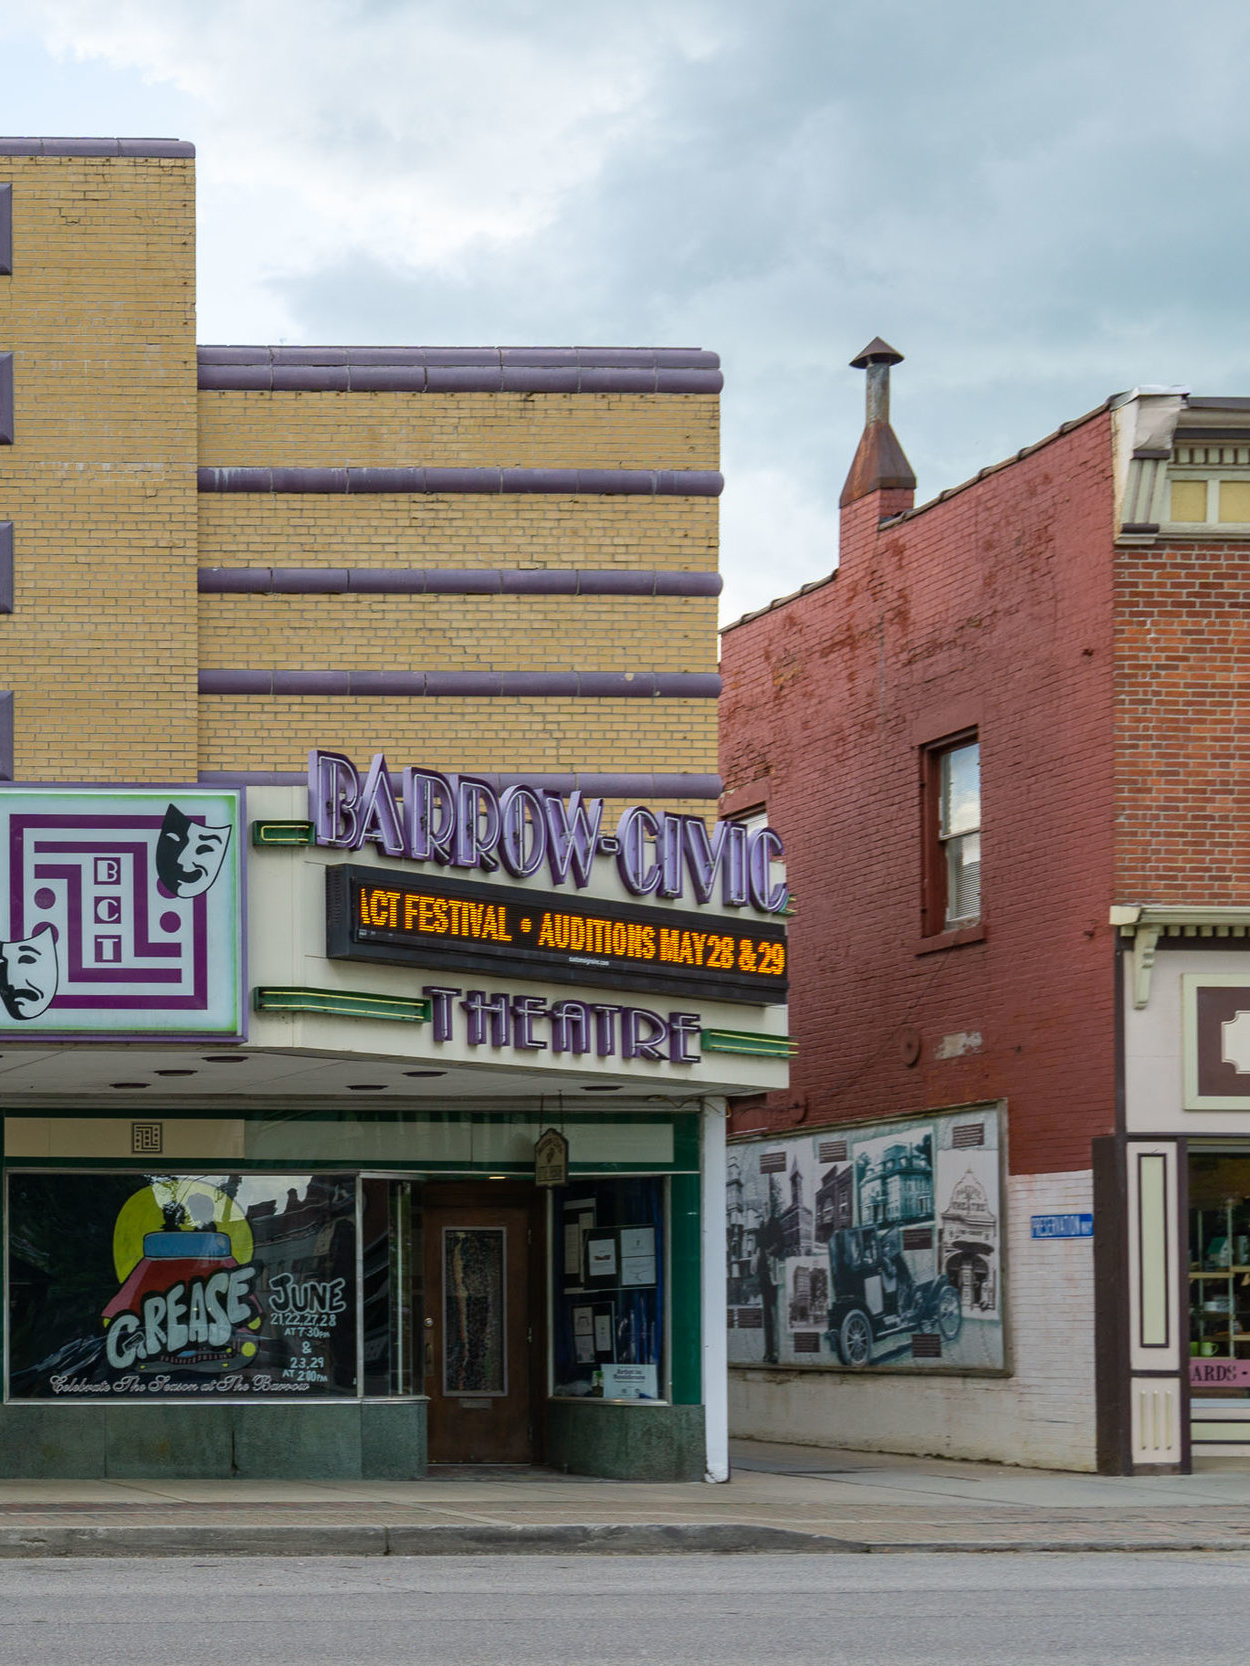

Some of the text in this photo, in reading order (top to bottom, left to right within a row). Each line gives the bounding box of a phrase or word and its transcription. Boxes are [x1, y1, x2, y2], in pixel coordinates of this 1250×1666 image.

[308, 749, 789, 914] BARROW-CIVIC
[404, 893, 513, 942] FESTIVAL
[537, 912, 656, 960] AUDITIONS
[422, 986, 703, 1065] THEATRE
[269, 1272, 347, 1315] JUNE
[105, 1266, 257, 1370] GREASE
[284, 1327, 296, 1336] AT
[301, 1341, 312, 1354] &
[50, 1374, 310, 1394] Celebrate The Season at The Barrow
[282, 1369, 295, 1378] AT
